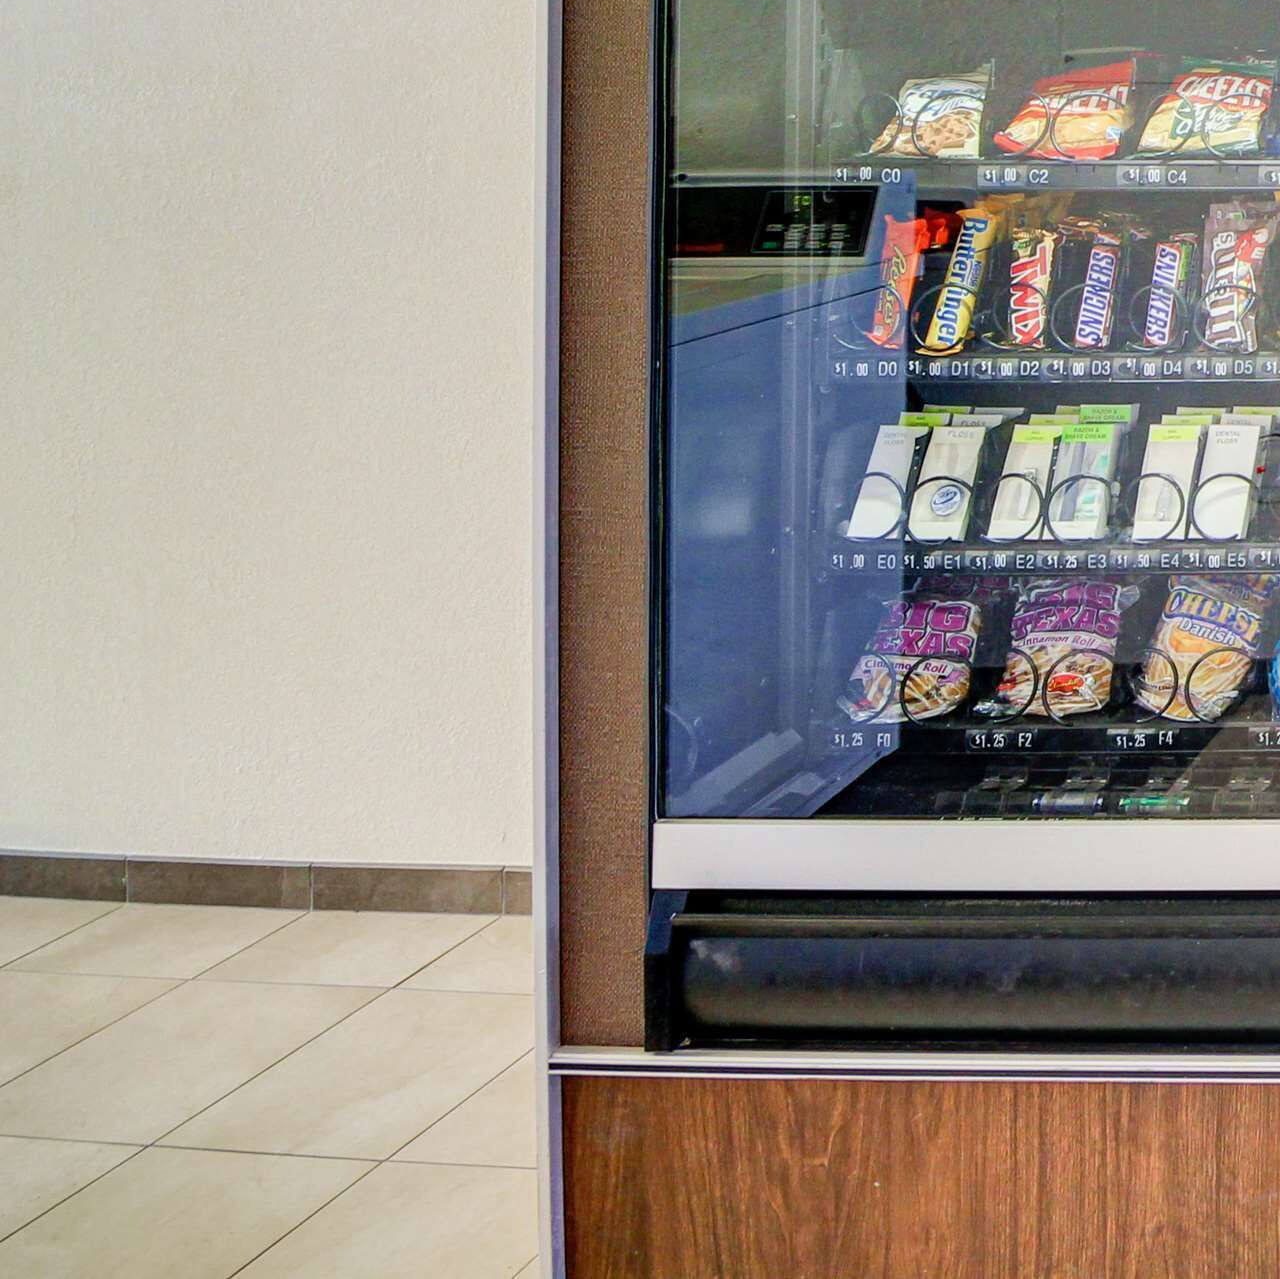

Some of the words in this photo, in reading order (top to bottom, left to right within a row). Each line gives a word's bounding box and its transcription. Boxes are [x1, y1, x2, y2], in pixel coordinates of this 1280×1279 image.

[836, 167, 872, 183] $1.00
[882, 168, 900, 183] C0
[985, 167, 1017, 183] $1.00
[1029, 169, 1049, 183] C2
[1129, 169, 1161, 184] $1.00
[1167, 170, 1187, 184] C4
[936, 218, 989, 347] Butterfinger
[1010, 243, 1049, 348] TWIX
[1077, 251, 1115, 348] SNICKERS
[1146, 246, 1179, 345] SNICKERS
[834, 362, 868, 376] $1.00
[878, 362, 897, 376] D0
[908, 361, 941, 376] $1.00
[952, 361, 969, 375] D1
[981, 361, 1012, 376] $1.00
[1020, 362, 1040, 375] D2
[1053, 360, 1085, 376] $1.00
[1092, 361, 1111, 375] D3
[1163, 361, 1182, 374] D4
[1196, 360, 1227, 376] $1.00
[1234, 360, 1253, 374] D5
[832, 554, 865, 569] $1.00
[877, 555, 896, 569] E0
[903, 554, 935, 569] $1.50
[943, 555, 961, 569] E1
[976, 554, 1006, 570] $1.00
[1016, 554, 1035, 568] E2
[1047, 554, 1077, 569] $1.25
[1088, 554, 1106, 569] E3
[1117, 553, 1149, 568] $1.50
[1160, 553, 1179, 567] E4
[1189, 553, 1220, 568] $1.00
[1228, 553, 1246, 567] E5
[1031, 583, 1119, 609] BIG
[884, 600, 971, 631] BIG
[1011, 606, 1121, 639] TEXAS
[1164, 587, 1262, 649] CHEESE
[1178, 617, 1236, 646] Danish
[1015, 634, 1069, 647] Cinnamon
[1071, 634, 1098, 648] Roll
[922, 661, 948, 675] Roll
[834, 733, 863, 747] $1.25
[877, 733, 891, 747] F0
[975, 734, 1004, 748] $1.25
[1018, 733, 1032, 747] F2
[1116, 734, 1146, 749] $1.25
[1158, 731, 1173, 745] F4
